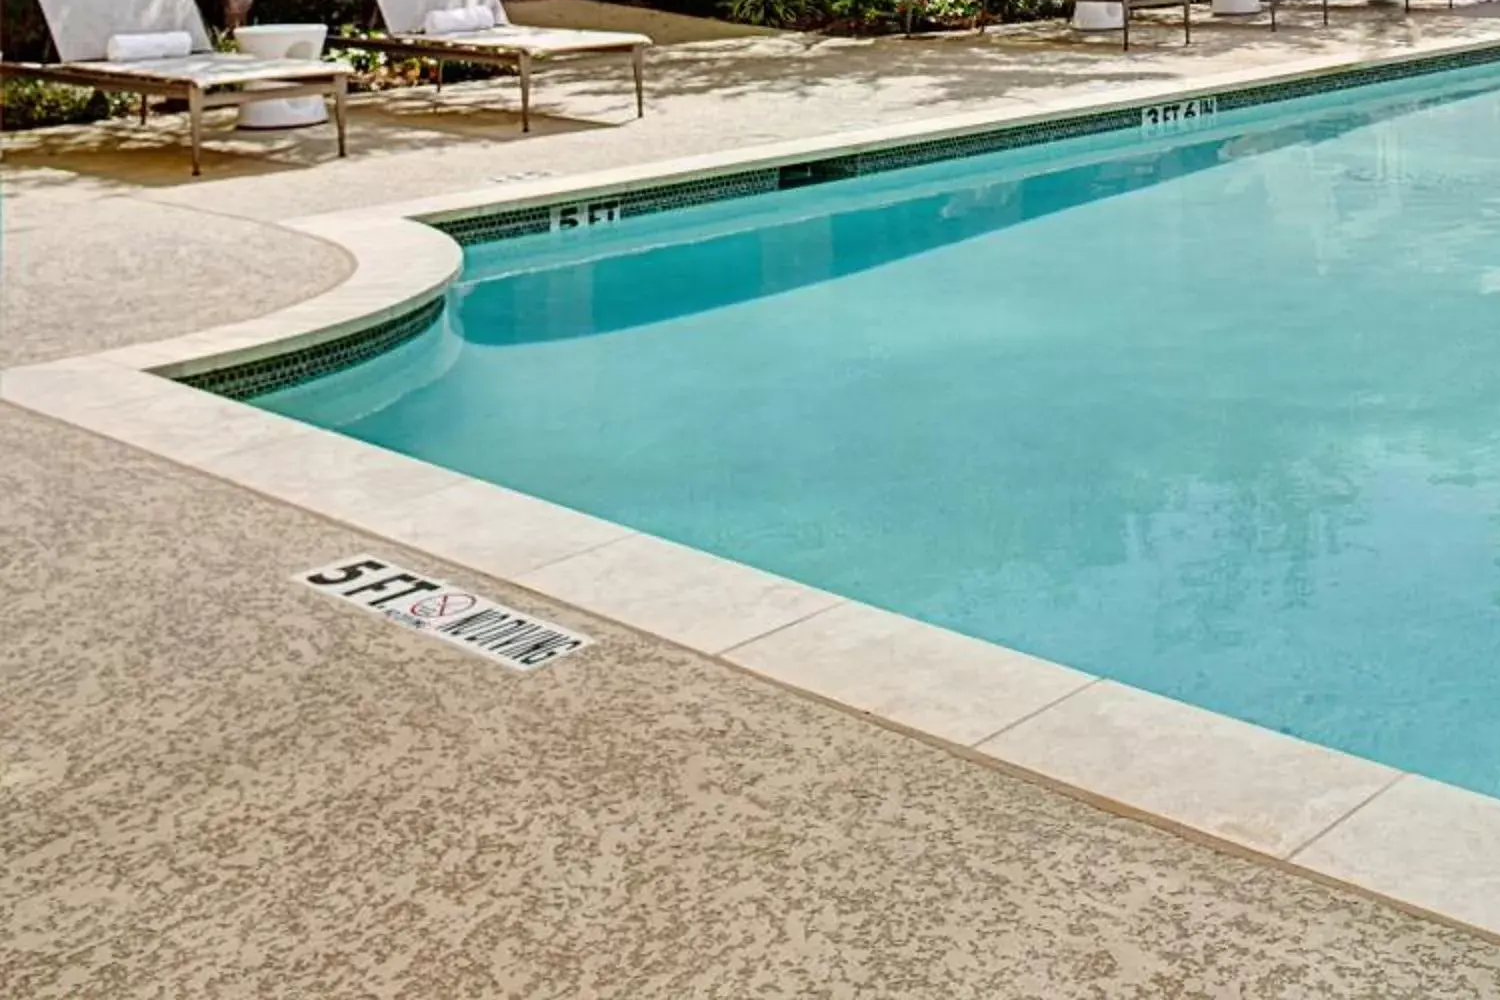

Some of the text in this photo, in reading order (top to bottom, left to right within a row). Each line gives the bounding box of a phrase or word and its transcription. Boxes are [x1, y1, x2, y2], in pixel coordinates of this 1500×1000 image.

[560, 200, 619, 231] 5 FT
[306, 560, 389, 585] 5
[464, 619, 582, 665] DIVING
